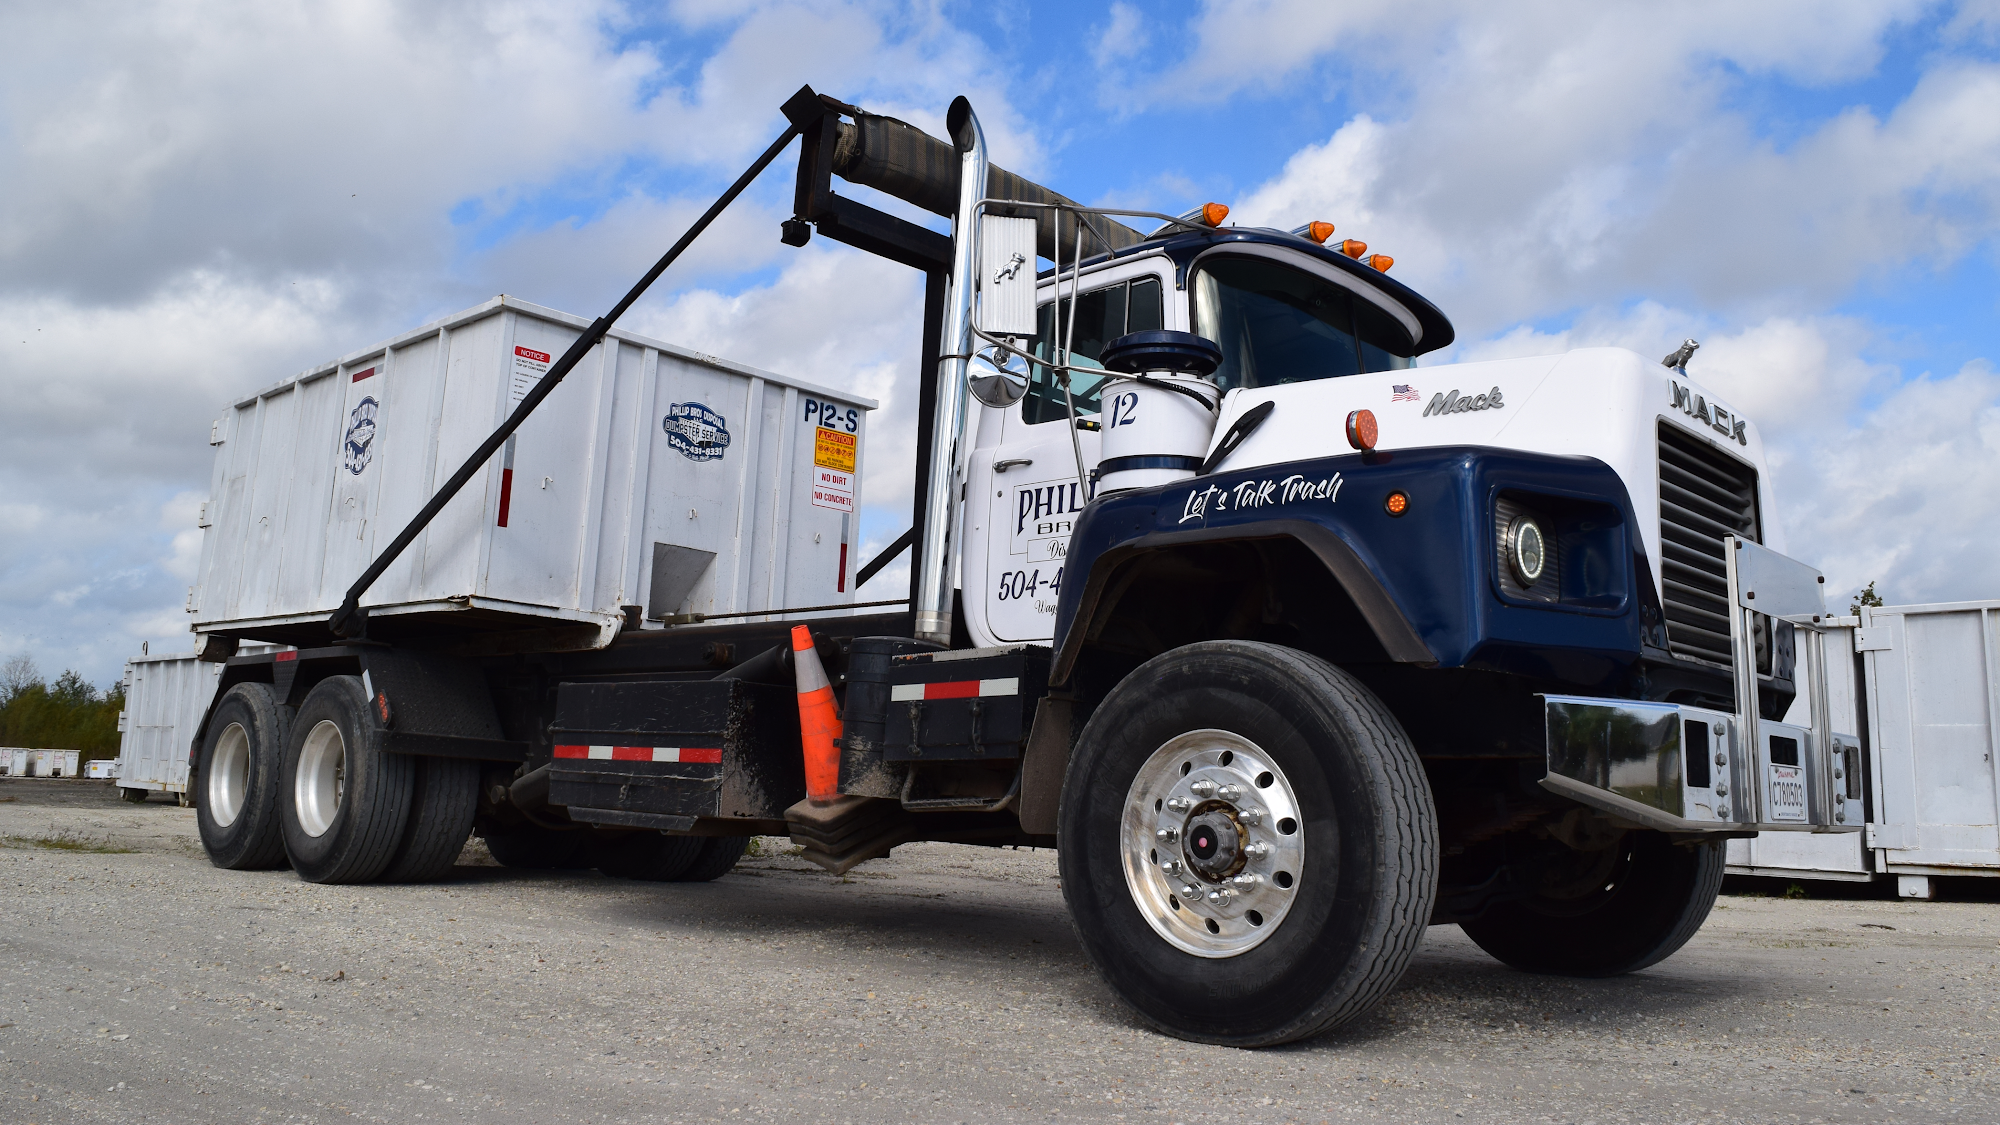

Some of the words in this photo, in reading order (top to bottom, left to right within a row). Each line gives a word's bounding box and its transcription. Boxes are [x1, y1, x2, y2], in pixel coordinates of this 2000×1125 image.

[520, 350, 544, 360] NOTICE
[1110, 392, 1139, 429] 12
[1422, 386, 1505, 417] Mack
[1666, 378, 1748, 446] MACK
[665, 418, 700, 439] DUMPSTER
[701, 430, 729, 446] SERVICE
[670, 435, 722, 456] 504-431-8331
[826, 432, 852, 445] CAUTION
[822, 473, 830, 482] NO
[832, 475, 847, 486] DIRT
[814, 491, 822, 500] NO
[824, 492, 852, 506] CONCRETE
[1178, 484, 1227, 524] Let's
[1233, 479, 1276, 510] Talk
[1280, 472, 1344, 505] Trash
[998, 567, 1064, 601] 504-4
